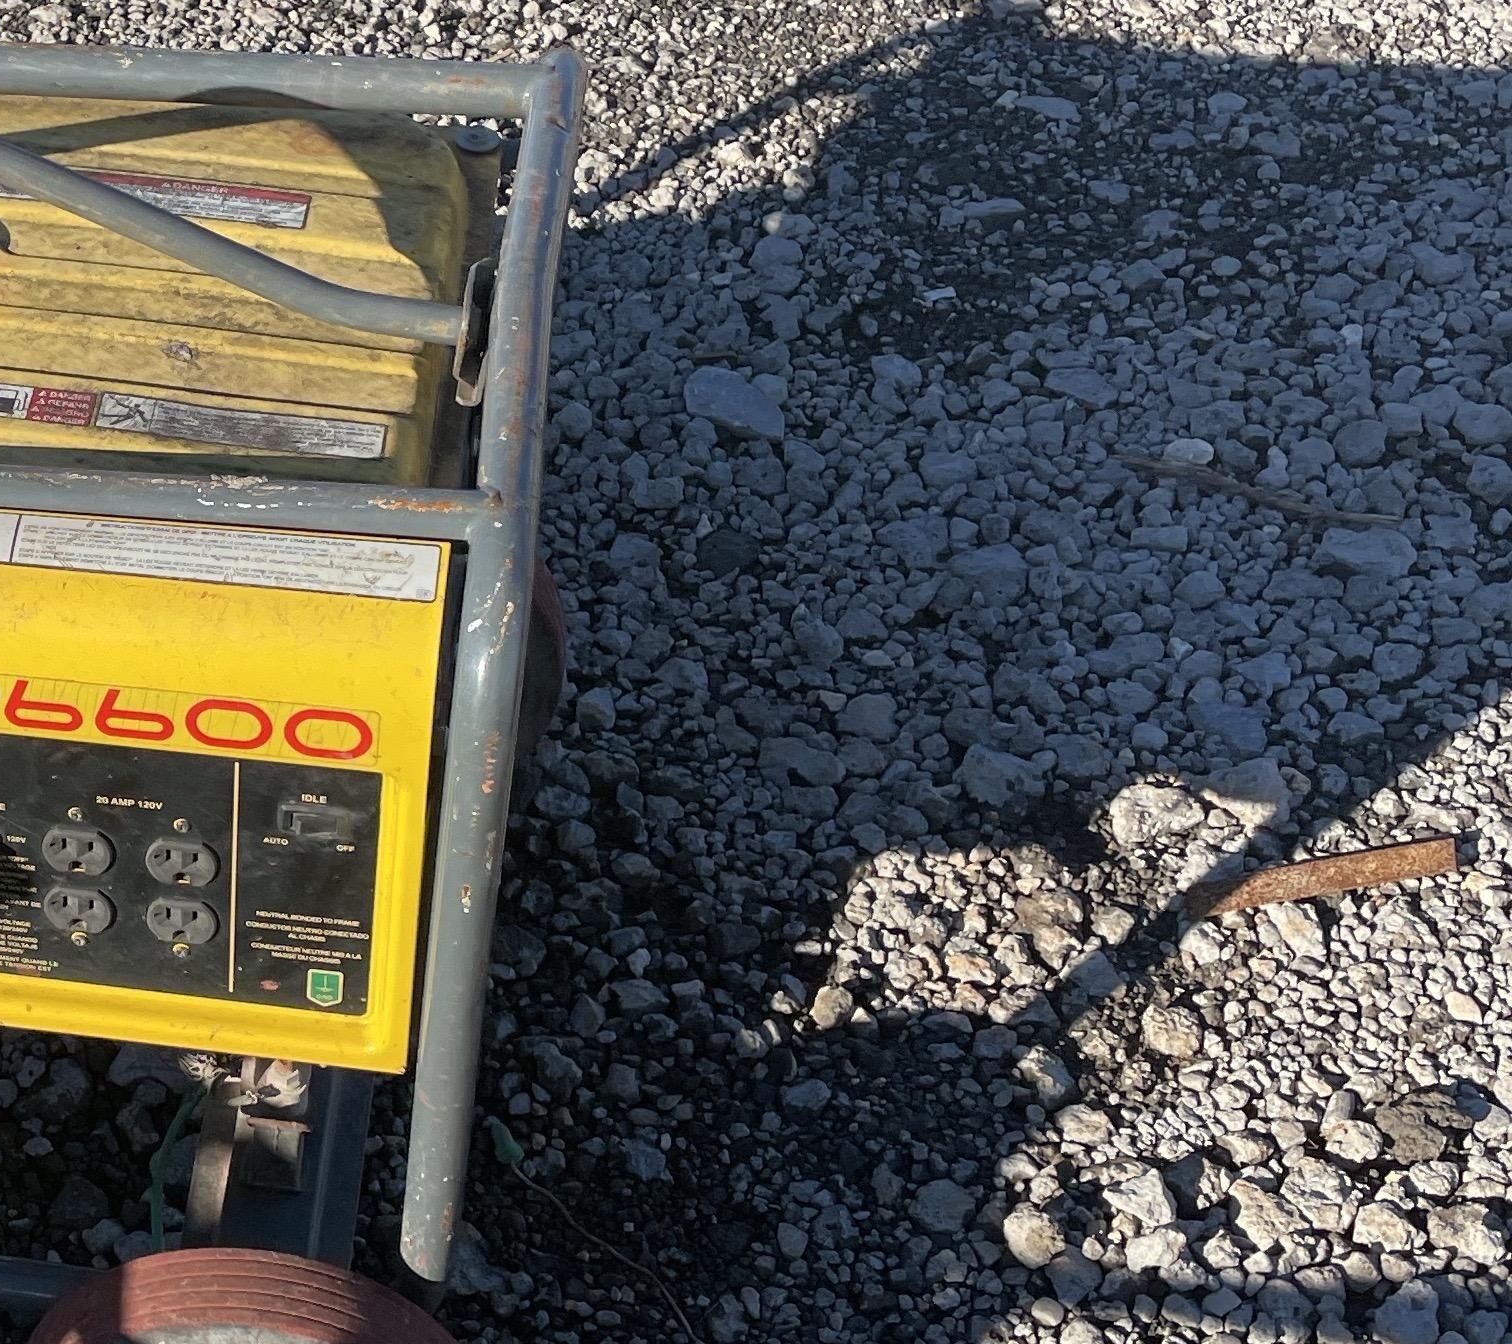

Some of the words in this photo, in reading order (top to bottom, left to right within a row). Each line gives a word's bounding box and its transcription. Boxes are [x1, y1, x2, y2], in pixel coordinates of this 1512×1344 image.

[172, 182, 229, 195] DANGER
[110, 797, 135, 807] AMP
[137, 800, 163, 811] 120V
[301, 793, 327, 804] IDLE
[263, 836, 289, 846] AUTO
[336, 844, 356, 853] OFF
